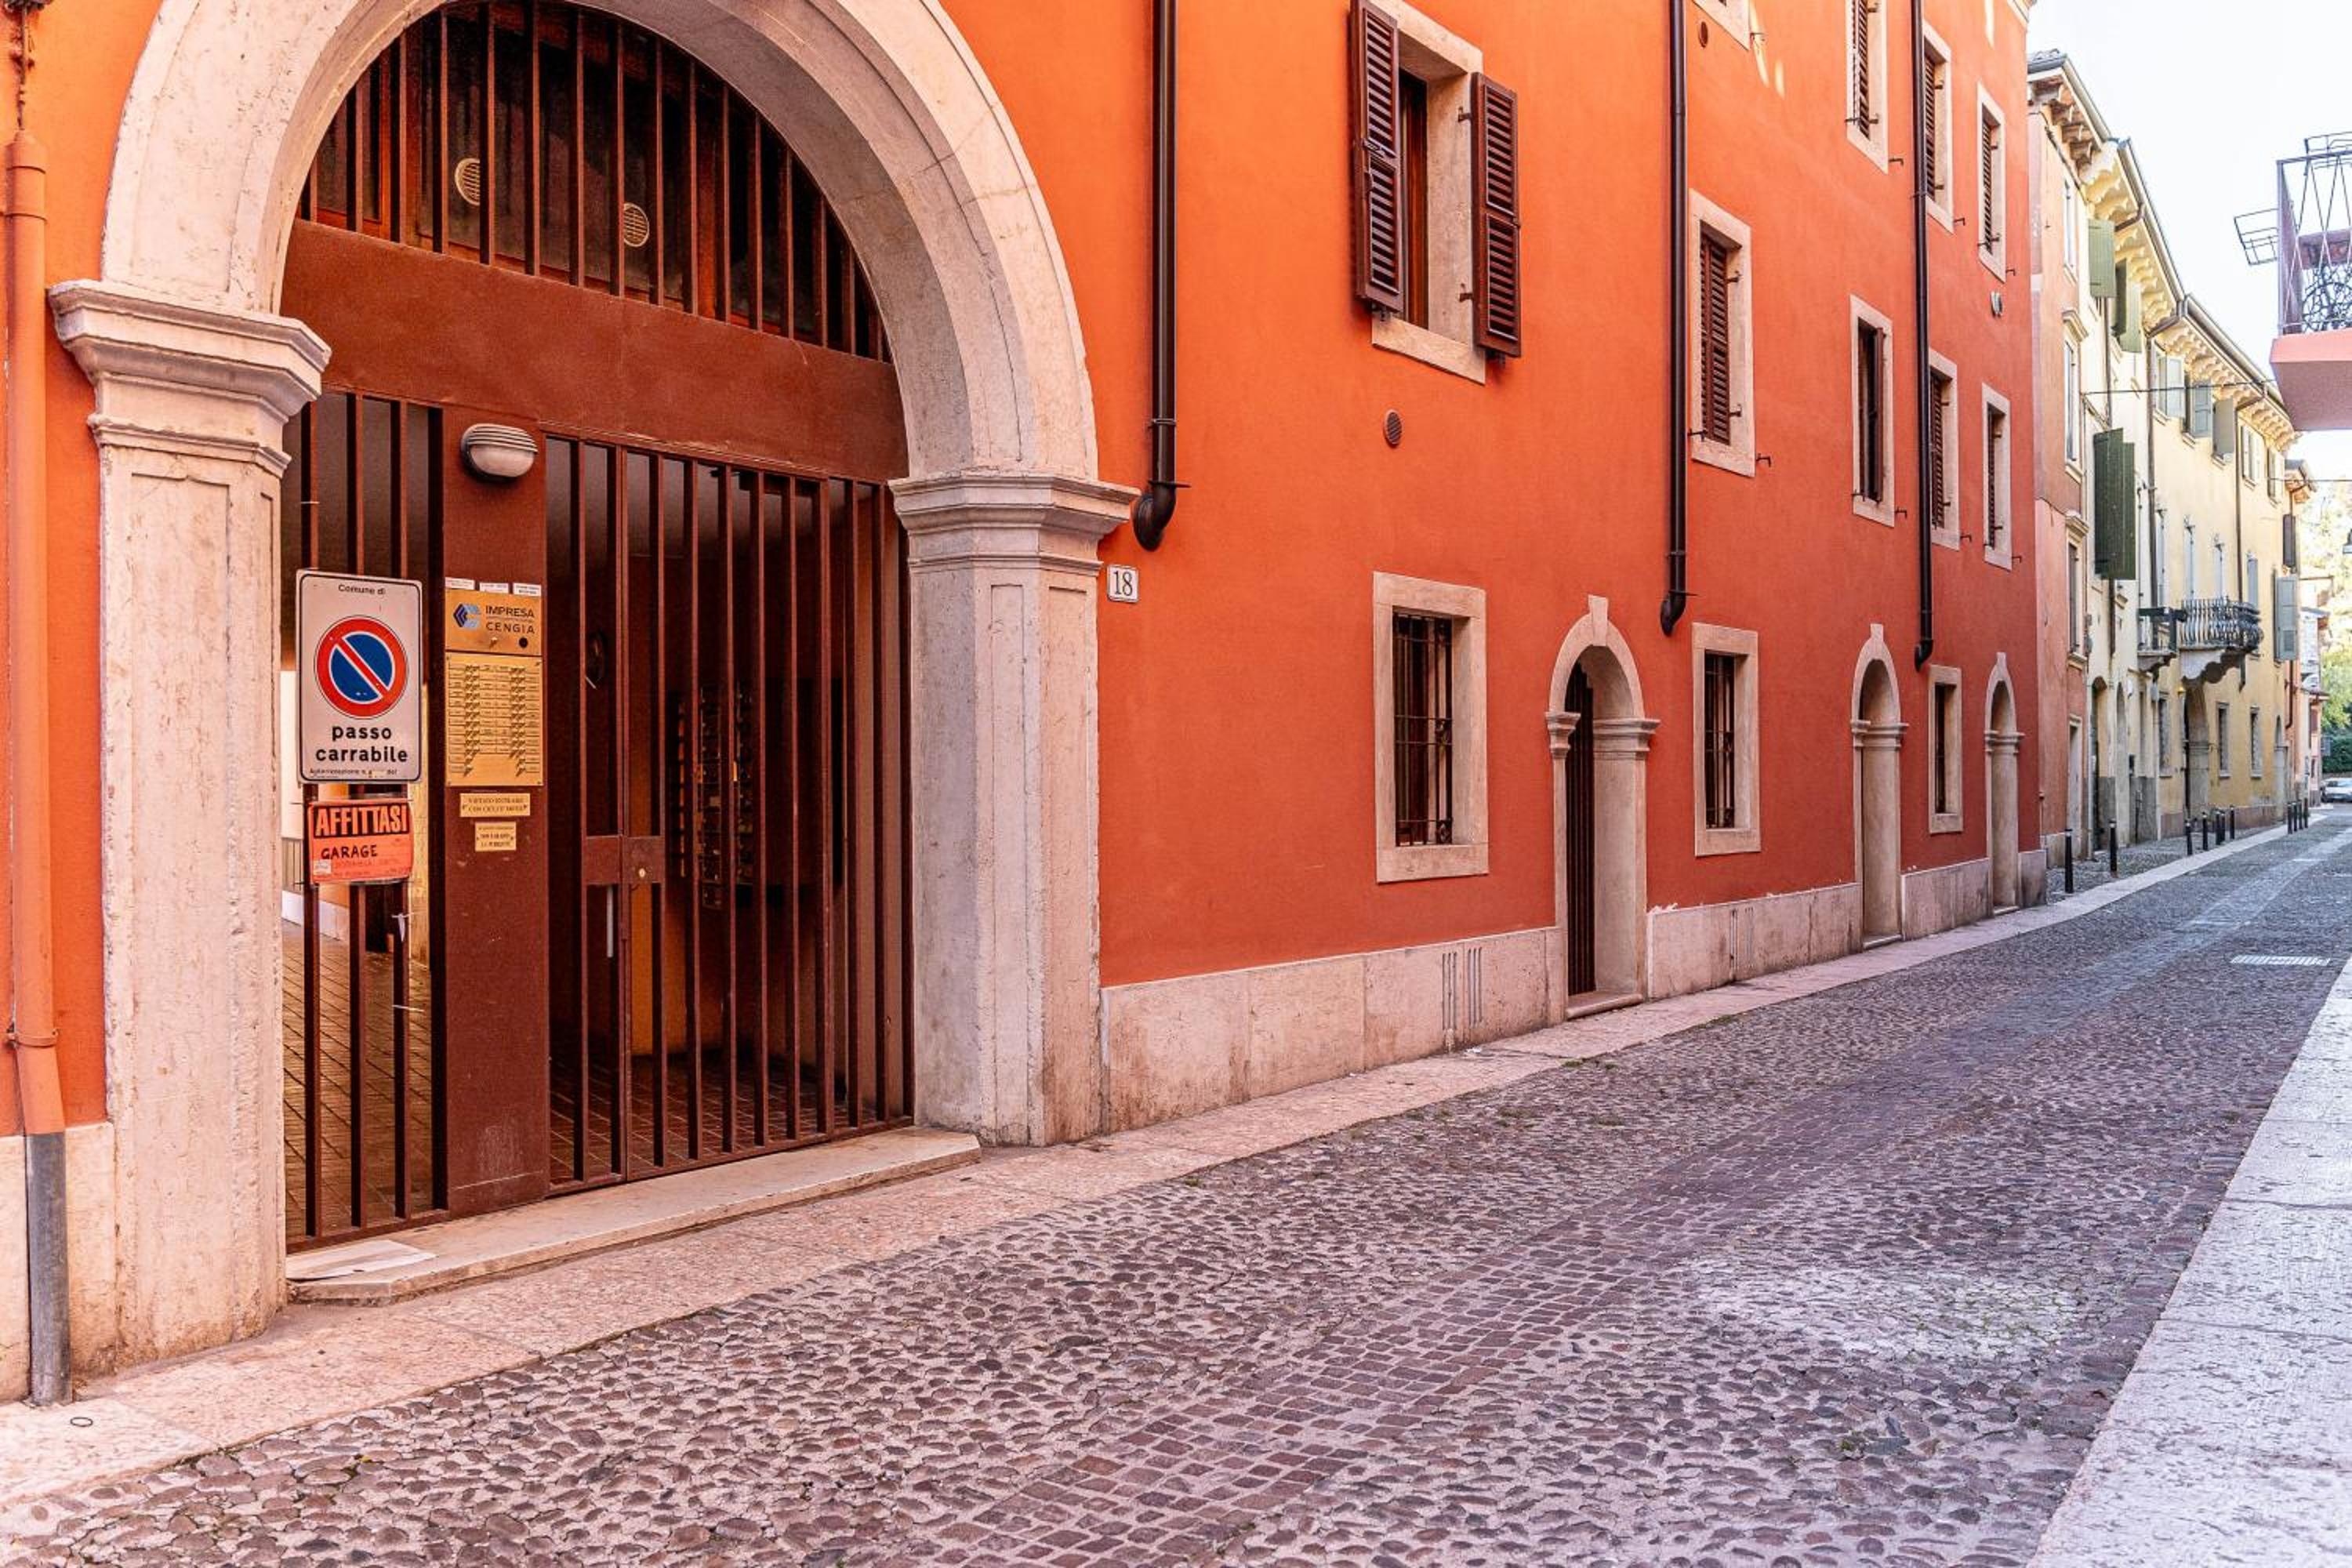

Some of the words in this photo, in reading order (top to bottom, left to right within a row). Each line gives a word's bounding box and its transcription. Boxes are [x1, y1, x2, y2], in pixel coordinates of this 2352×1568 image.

[338, 584, 375, 594] Comune
[1113, 570, 1133, 596] 18
[485, 604, 535, 618] IMPRESA
[485, 622, 535, 634] CENGIA
[332, 726, 391, 742] passo
[315, 746, 408, 762] carrabile
[315, 805, 407, 837] AFFITTASI
[321, 844, 378, 860] GARAGE
